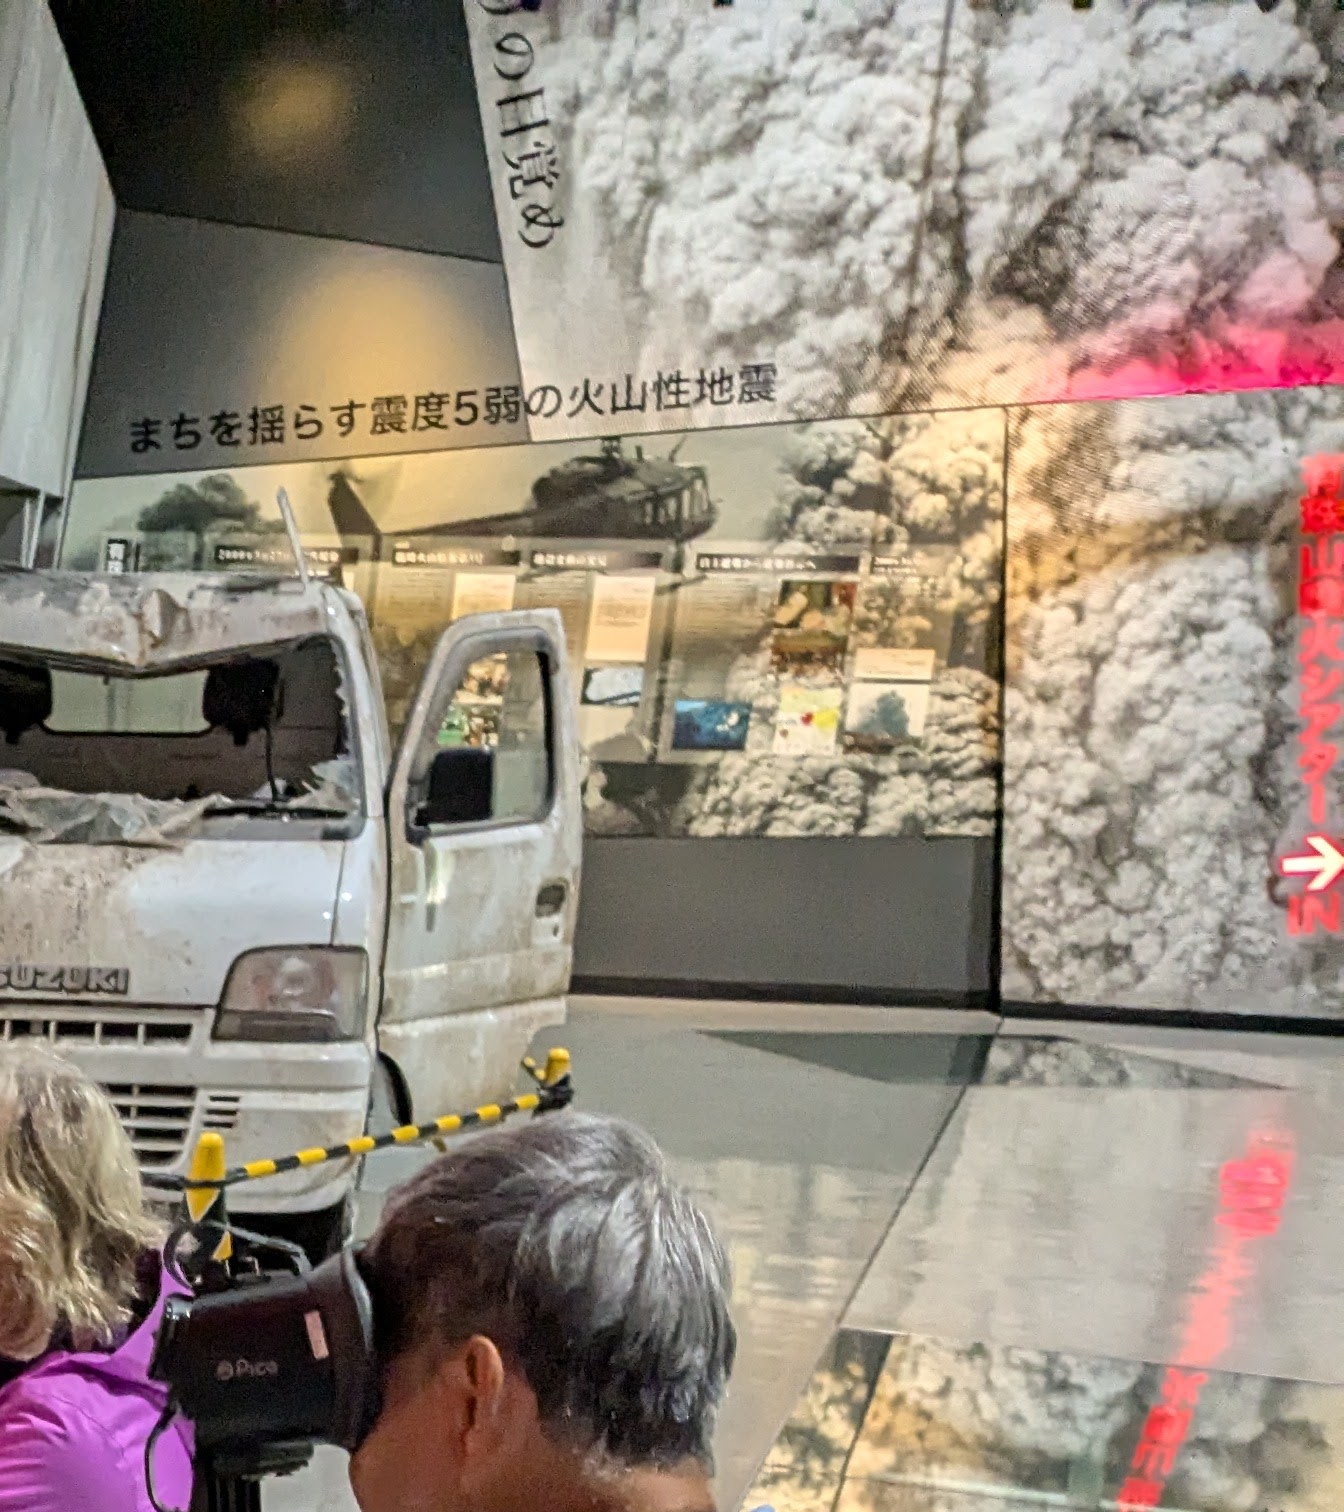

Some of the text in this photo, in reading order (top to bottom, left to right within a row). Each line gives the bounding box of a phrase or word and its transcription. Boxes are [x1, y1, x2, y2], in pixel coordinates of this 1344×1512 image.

[129, 363, 778, 455] まちを揺らす震度5弱の火山性地震
